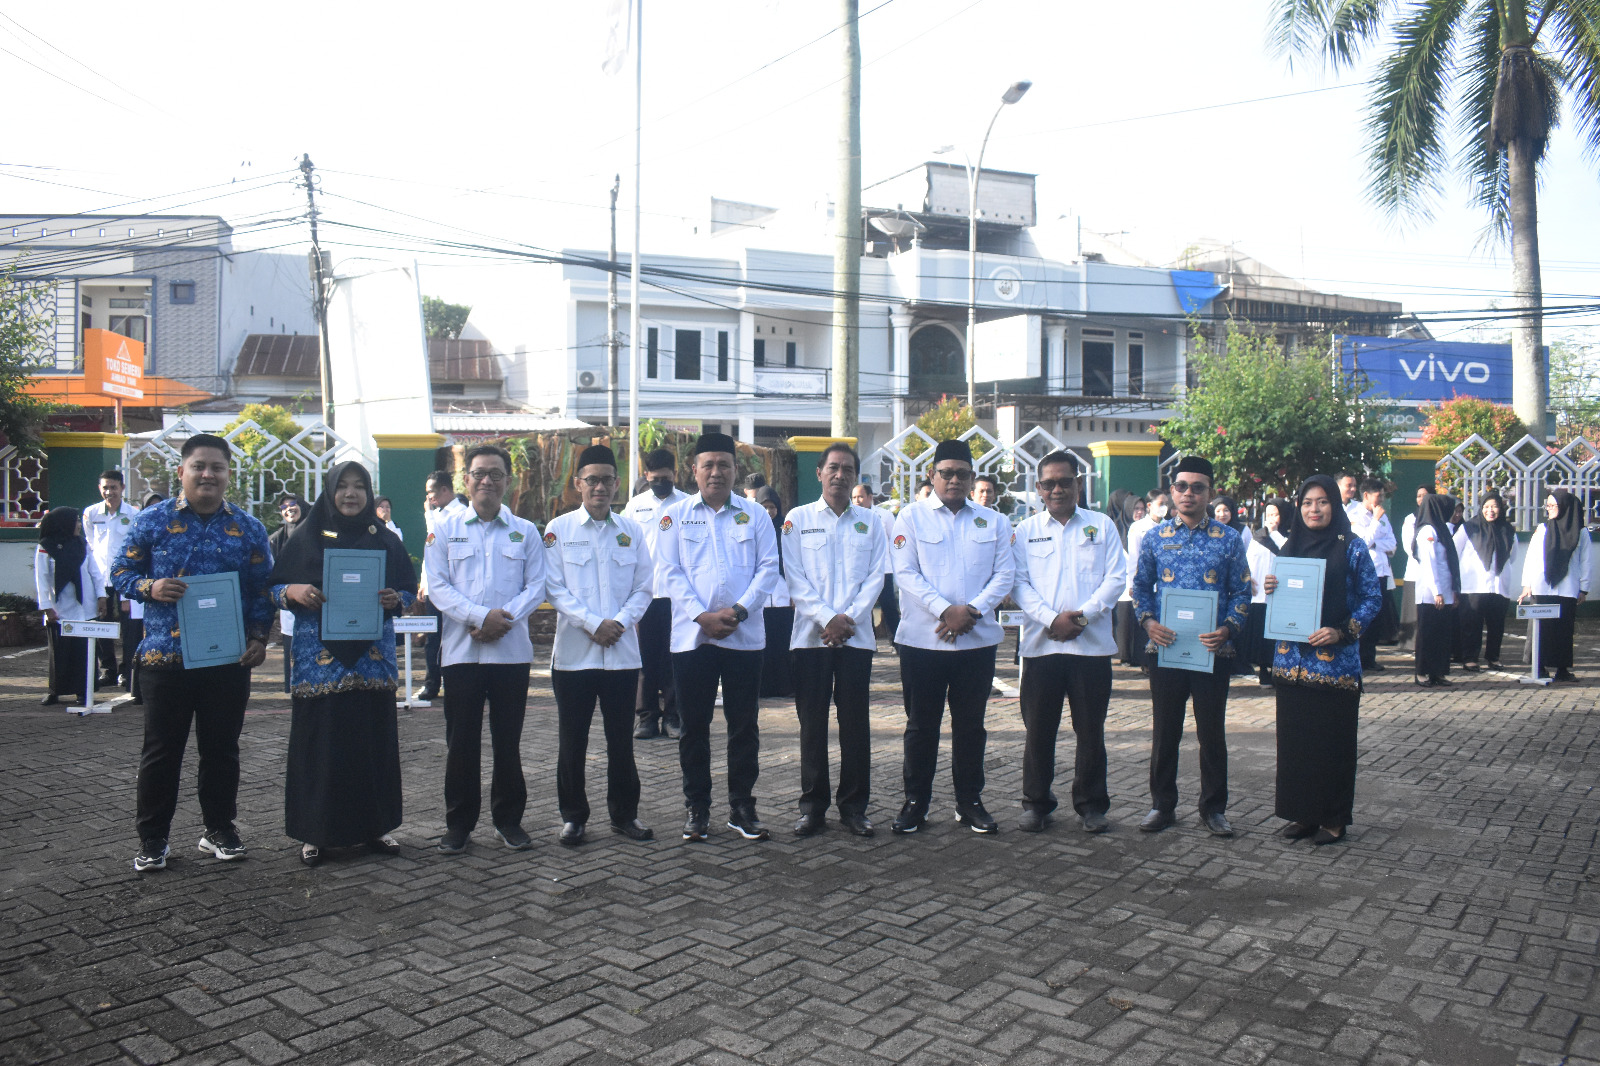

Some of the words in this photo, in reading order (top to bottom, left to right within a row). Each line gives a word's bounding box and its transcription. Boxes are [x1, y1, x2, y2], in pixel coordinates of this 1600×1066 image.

[105, 357, 121, 373] TOKO
[121, 361, 142, 379] SEMERU
[1399, 353, 1490, 384] vivo
